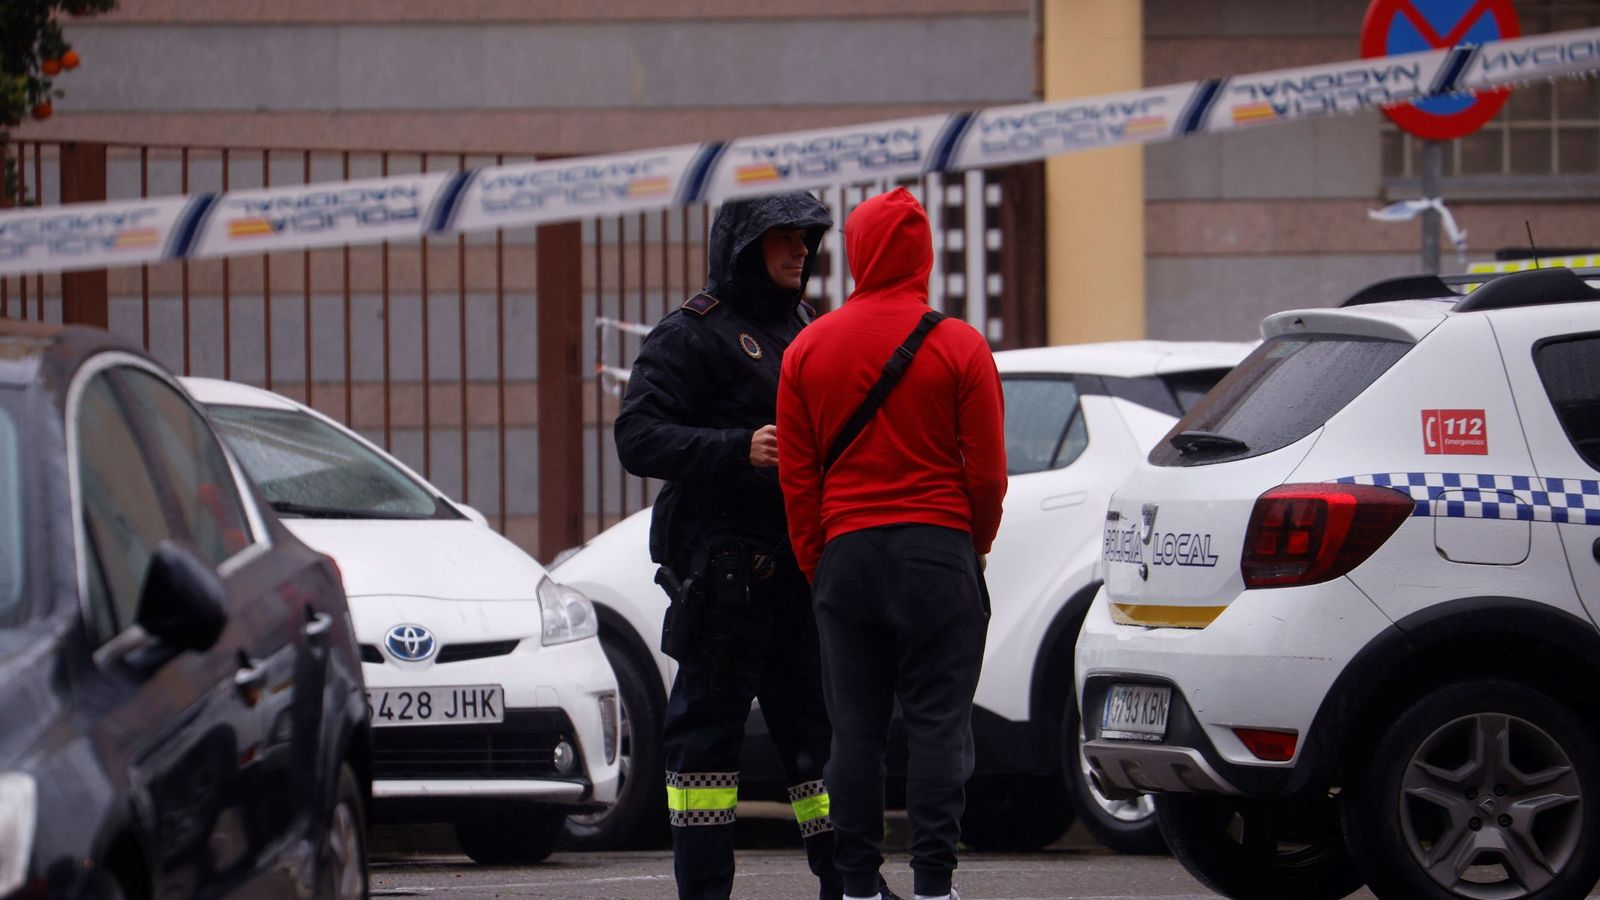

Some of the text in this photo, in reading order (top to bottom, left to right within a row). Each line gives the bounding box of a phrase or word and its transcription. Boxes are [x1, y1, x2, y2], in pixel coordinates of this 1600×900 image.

[1444, 418, 1482, 435] 112
[1153, 533, 1219, 567] LOCAL
[444, 689, 497, 718] JHK
[1141, 692, 1168, 726] KBN
